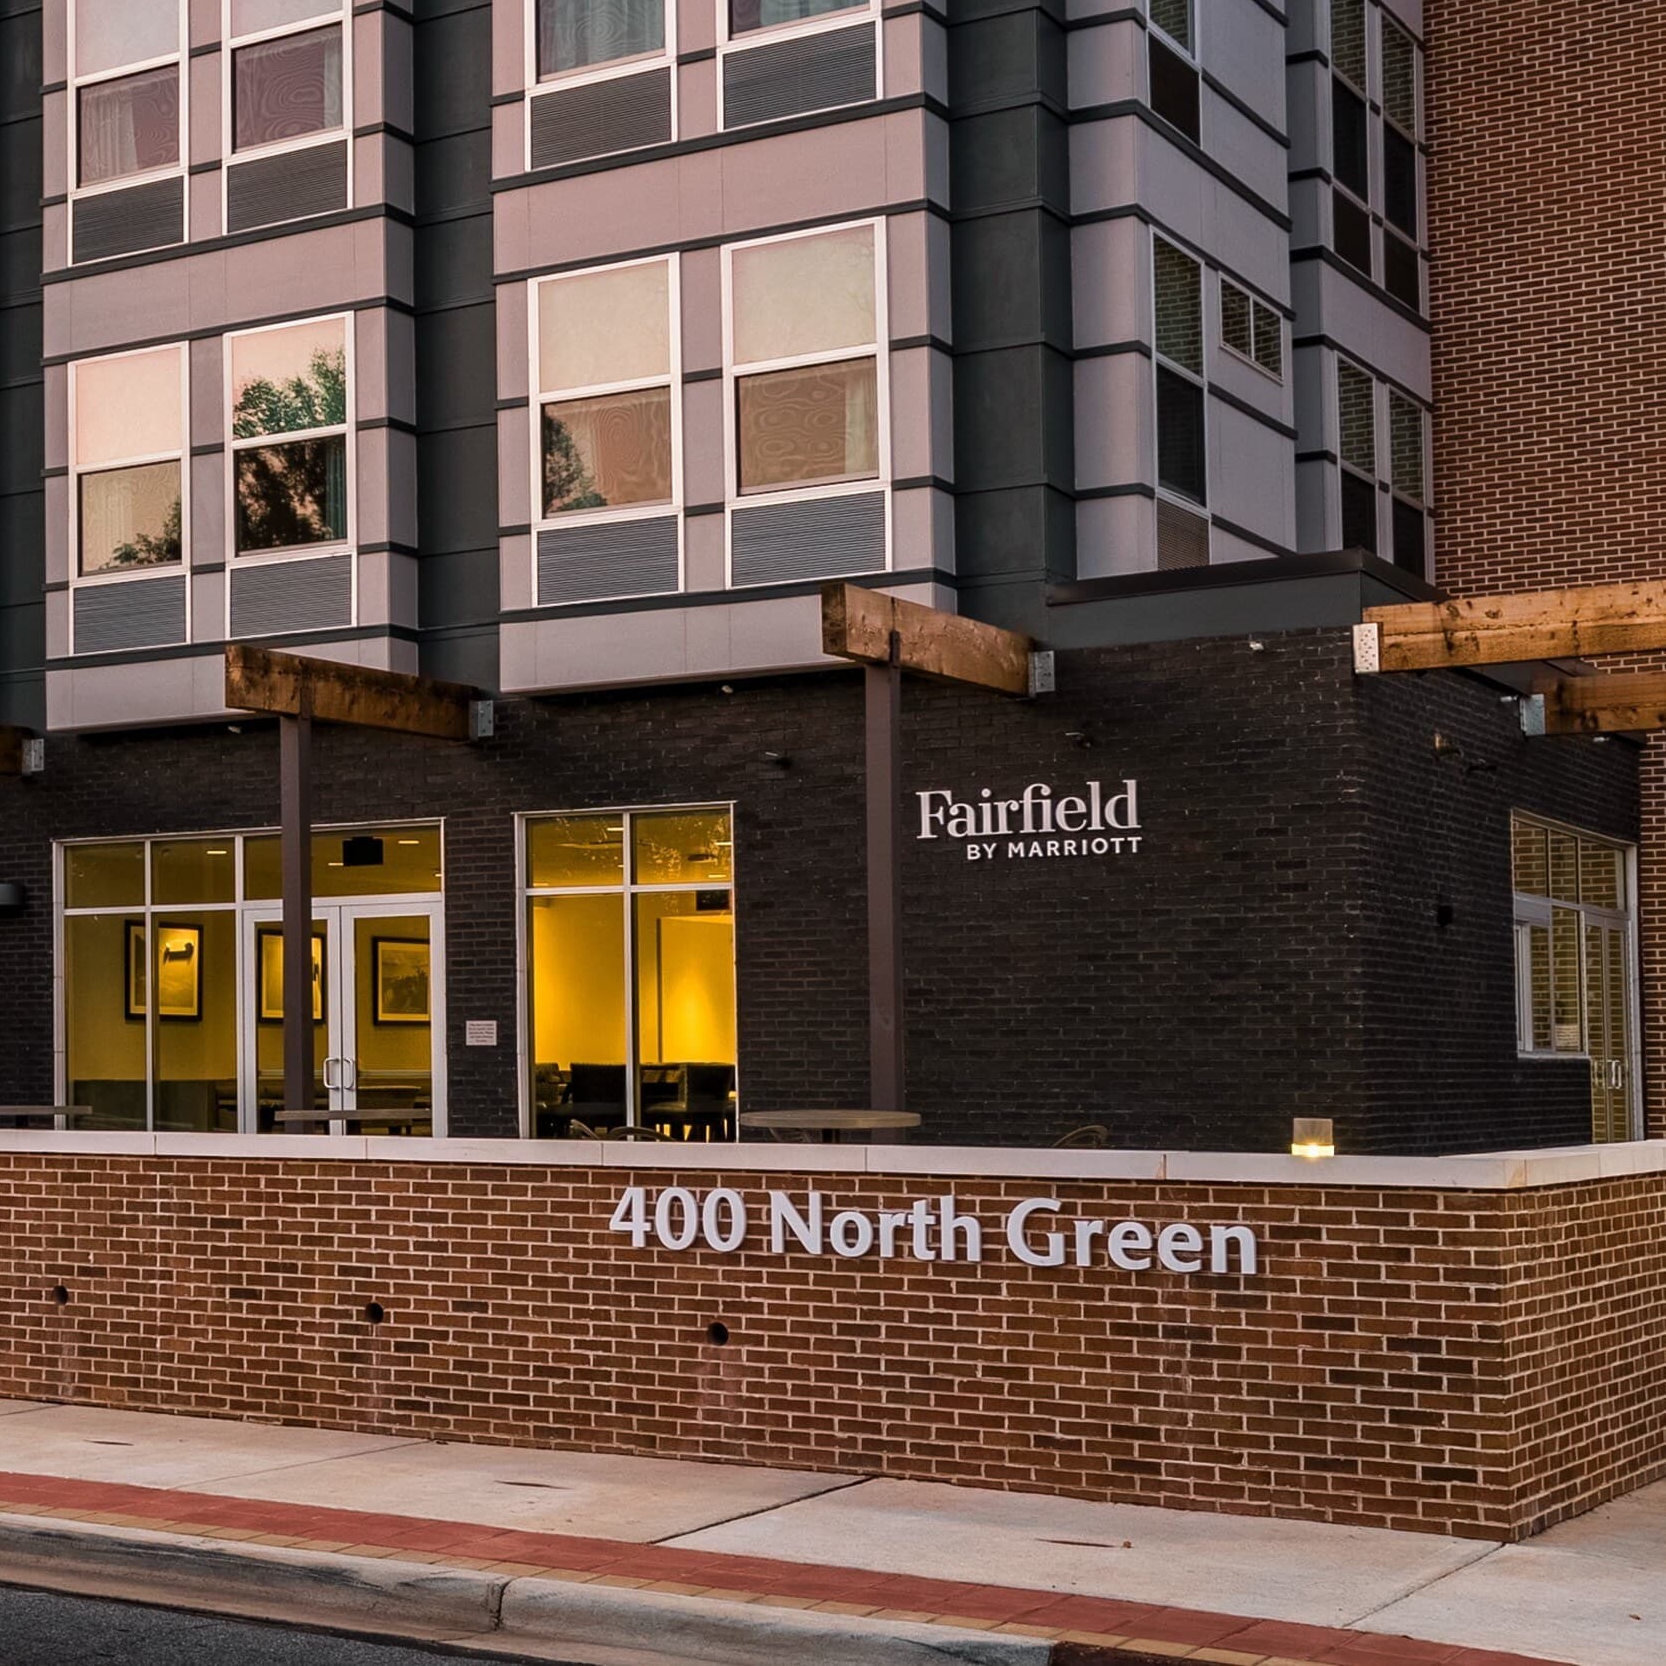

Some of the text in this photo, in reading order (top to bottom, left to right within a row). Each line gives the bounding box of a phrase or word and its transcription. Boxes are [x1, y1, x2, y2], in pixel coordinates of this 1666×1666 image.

[915, 779, 1142, 840] Fairfield
[966, 836, 1143, 861] BY MARRIOTT
[609, 1186, 1258, 1276] 400 North Green
